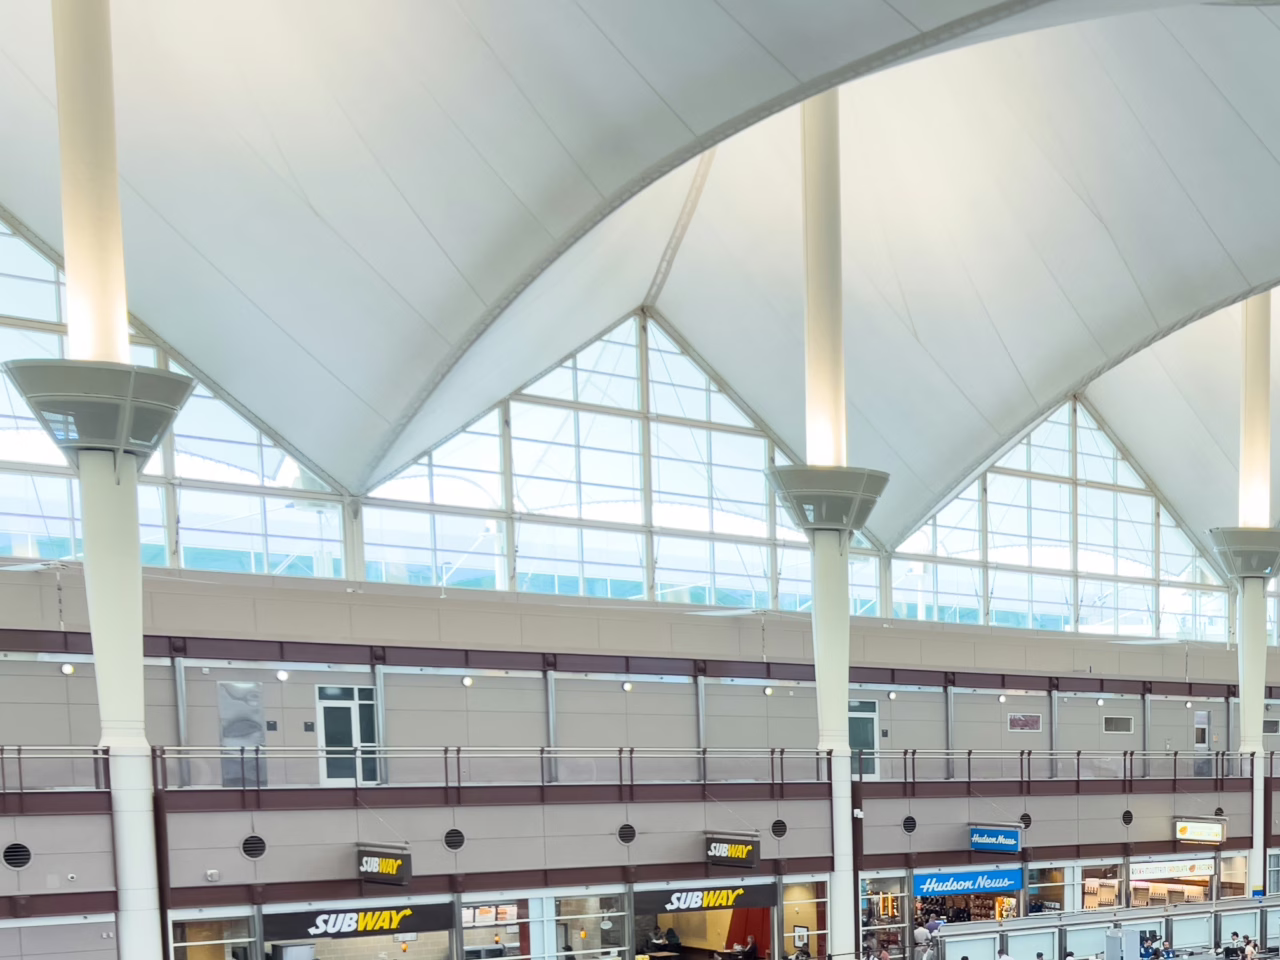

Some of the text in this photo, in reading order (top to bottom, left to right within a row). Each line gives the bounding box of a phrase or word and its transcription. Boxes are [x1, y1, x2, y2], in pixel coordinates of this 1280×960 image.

[971, 834, 1017, 845] Hudson News
[707, 842, 752, 858] SUBWAY
[359, 856, 402, 874] SUBWAY
[920, 876, 1014, 892] Hudson News
[665, 888, 744, 910] SUBWAY
[308, 908, 412, 935] SUBWAY
